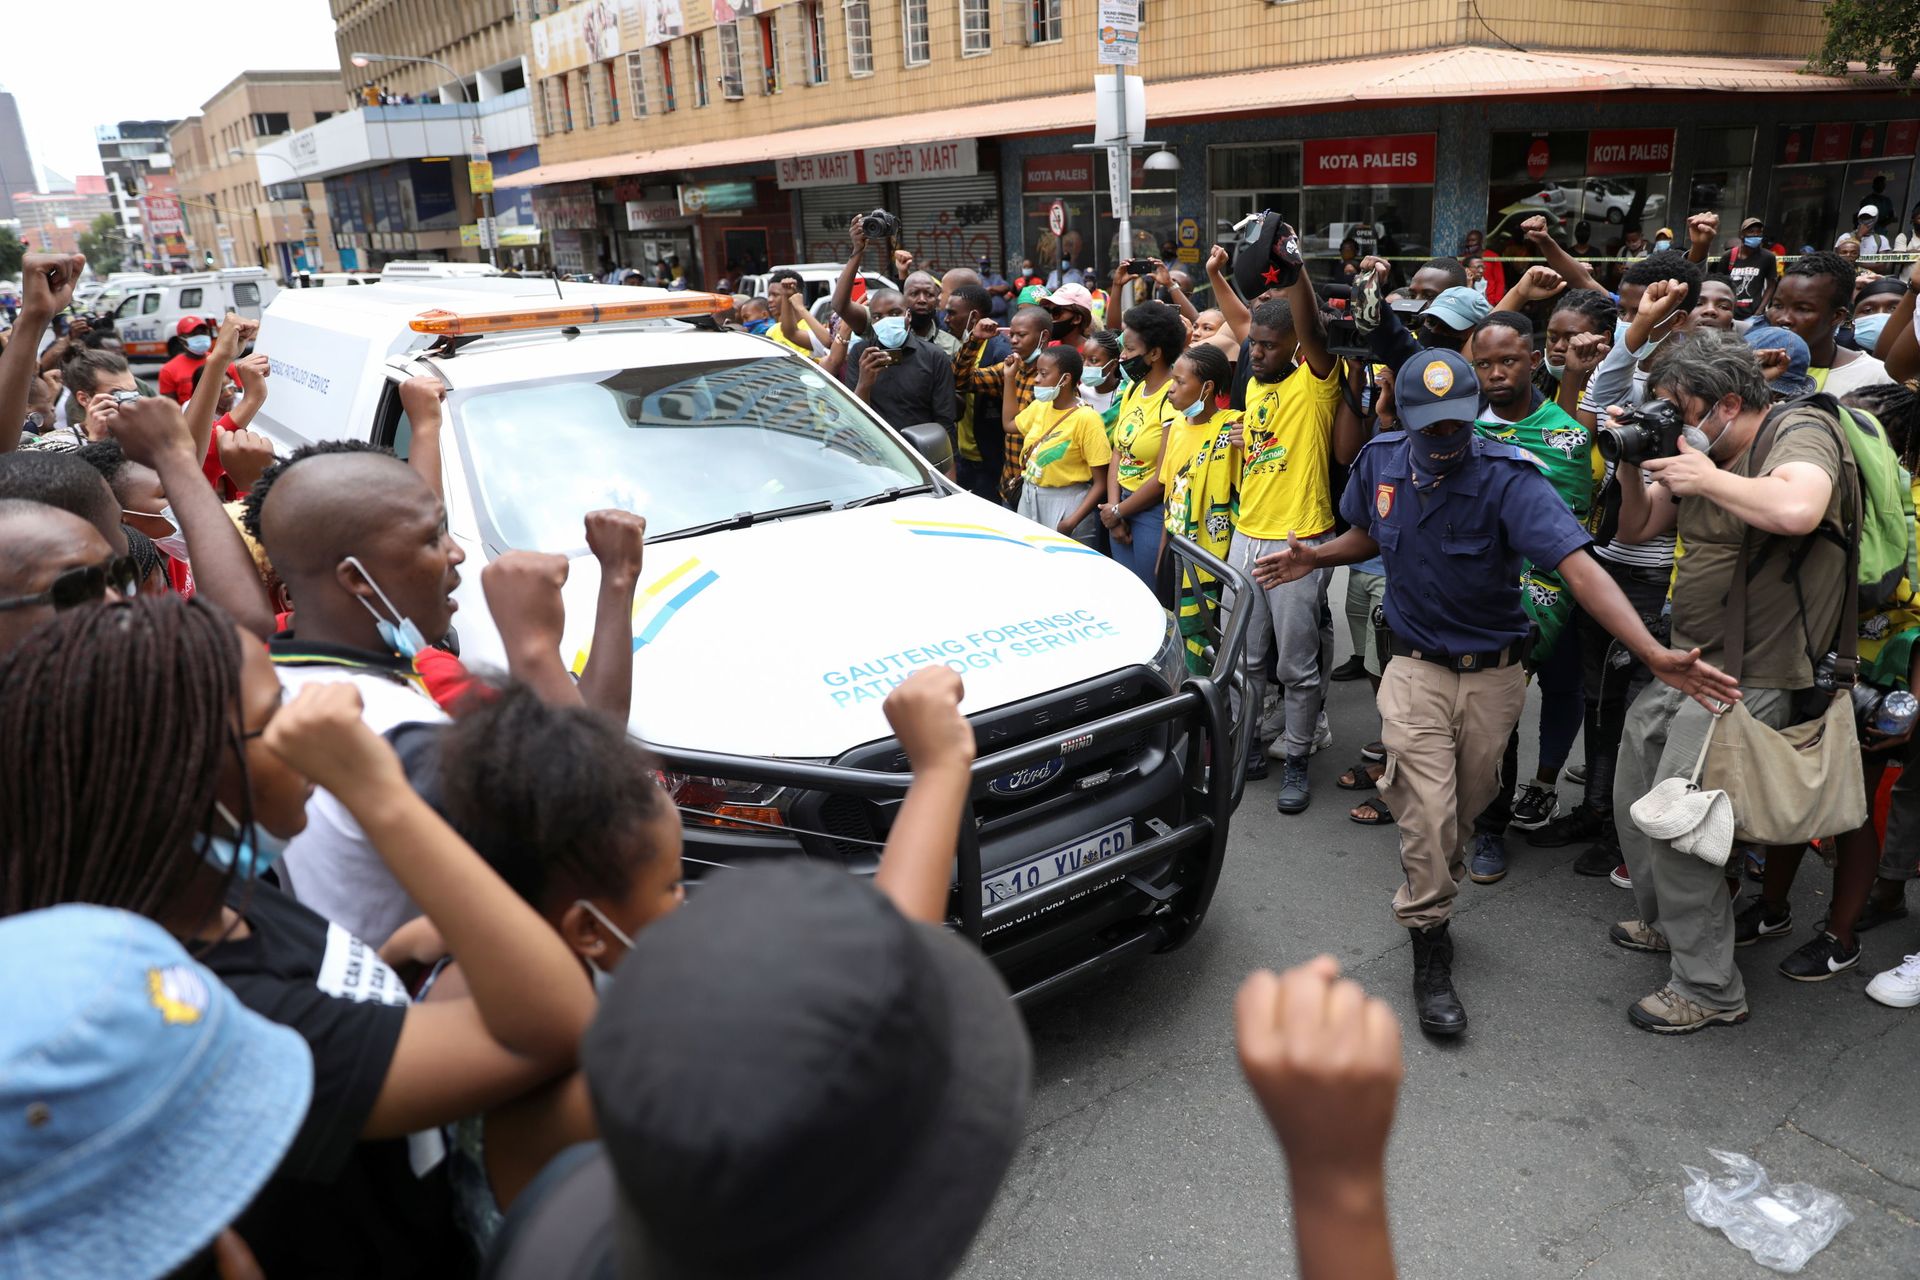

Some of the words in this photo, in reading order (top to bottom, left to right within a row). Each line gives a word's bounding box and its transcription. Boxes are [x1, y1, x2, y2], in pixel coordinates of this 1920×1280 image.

[873, 150, 912, 176] SUPER
[920, 144, 958, 172] MART
[1319, 154, 1359, 169] KOTA
[1363, 152, 1417, 168] PALEIS
[1594, 145, 1626, 162] KOTA
[1629, 144, 1669, 161] PALEIS
[781, 160, 814, 183] SUPER
[817, 155, 849, 179] MART
[1028, 171, 1053, 182] KOTA
[1055, 169, 1088, 181] PALEIS
[123, 328, 156, 341] POLICE
[1216, 535, 1228, 543] ANC
[822, 639, 965, 687] GAUTENG
[965, 609, 1096, 648] FORENSIC
[830, 648, 1004, 708] PATHOGY
[1009, 621, 1121, 658] SERVICE
[1060, 734, 1093, 755] RHINO
[1009, 760, 1051, 789] Ford
[1012, 866, 1040, 892] 10
